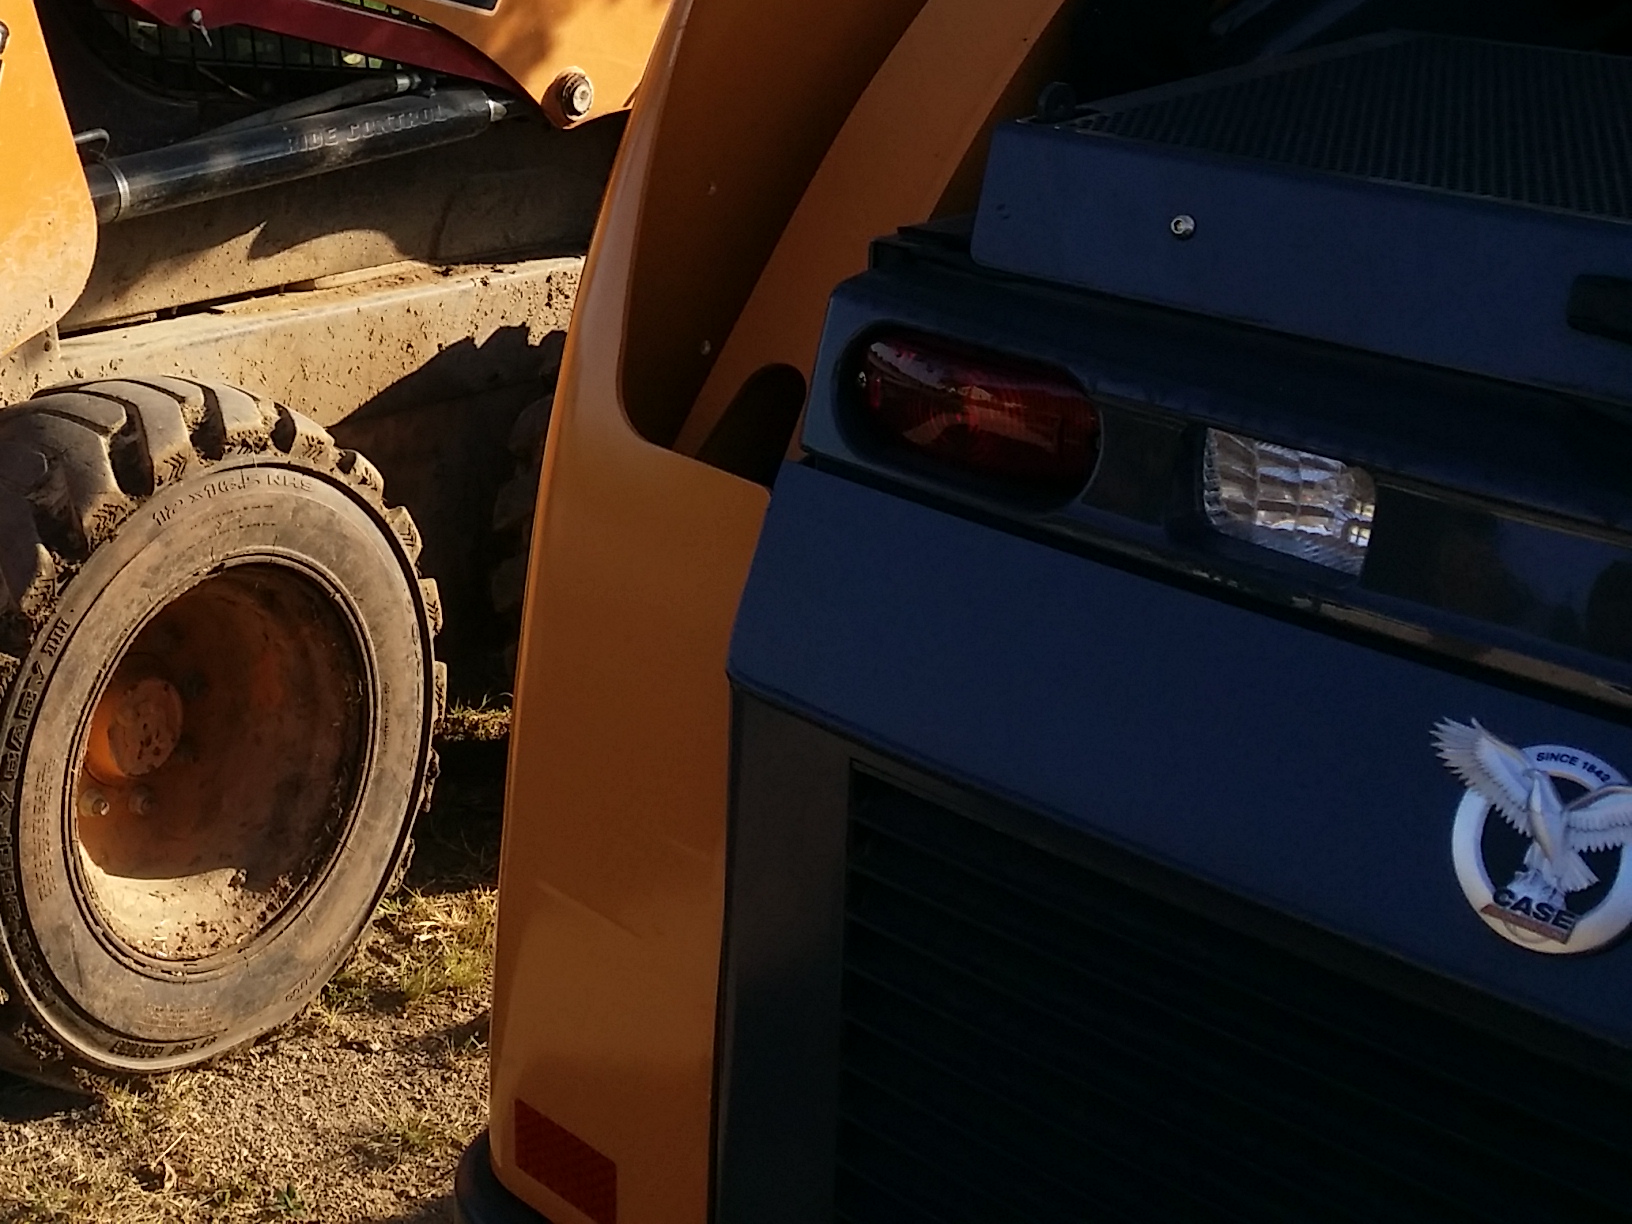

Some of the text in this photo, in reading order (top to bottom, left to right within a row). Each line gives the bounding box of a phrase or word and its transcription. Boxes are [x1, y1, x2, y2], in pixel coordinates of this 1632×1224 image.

[285, 104, 449, 155] RIDE CONTROL
[1536, 752, 1612, 783] SINCE 1842
[1492, 887, 1577, 931] CASE
